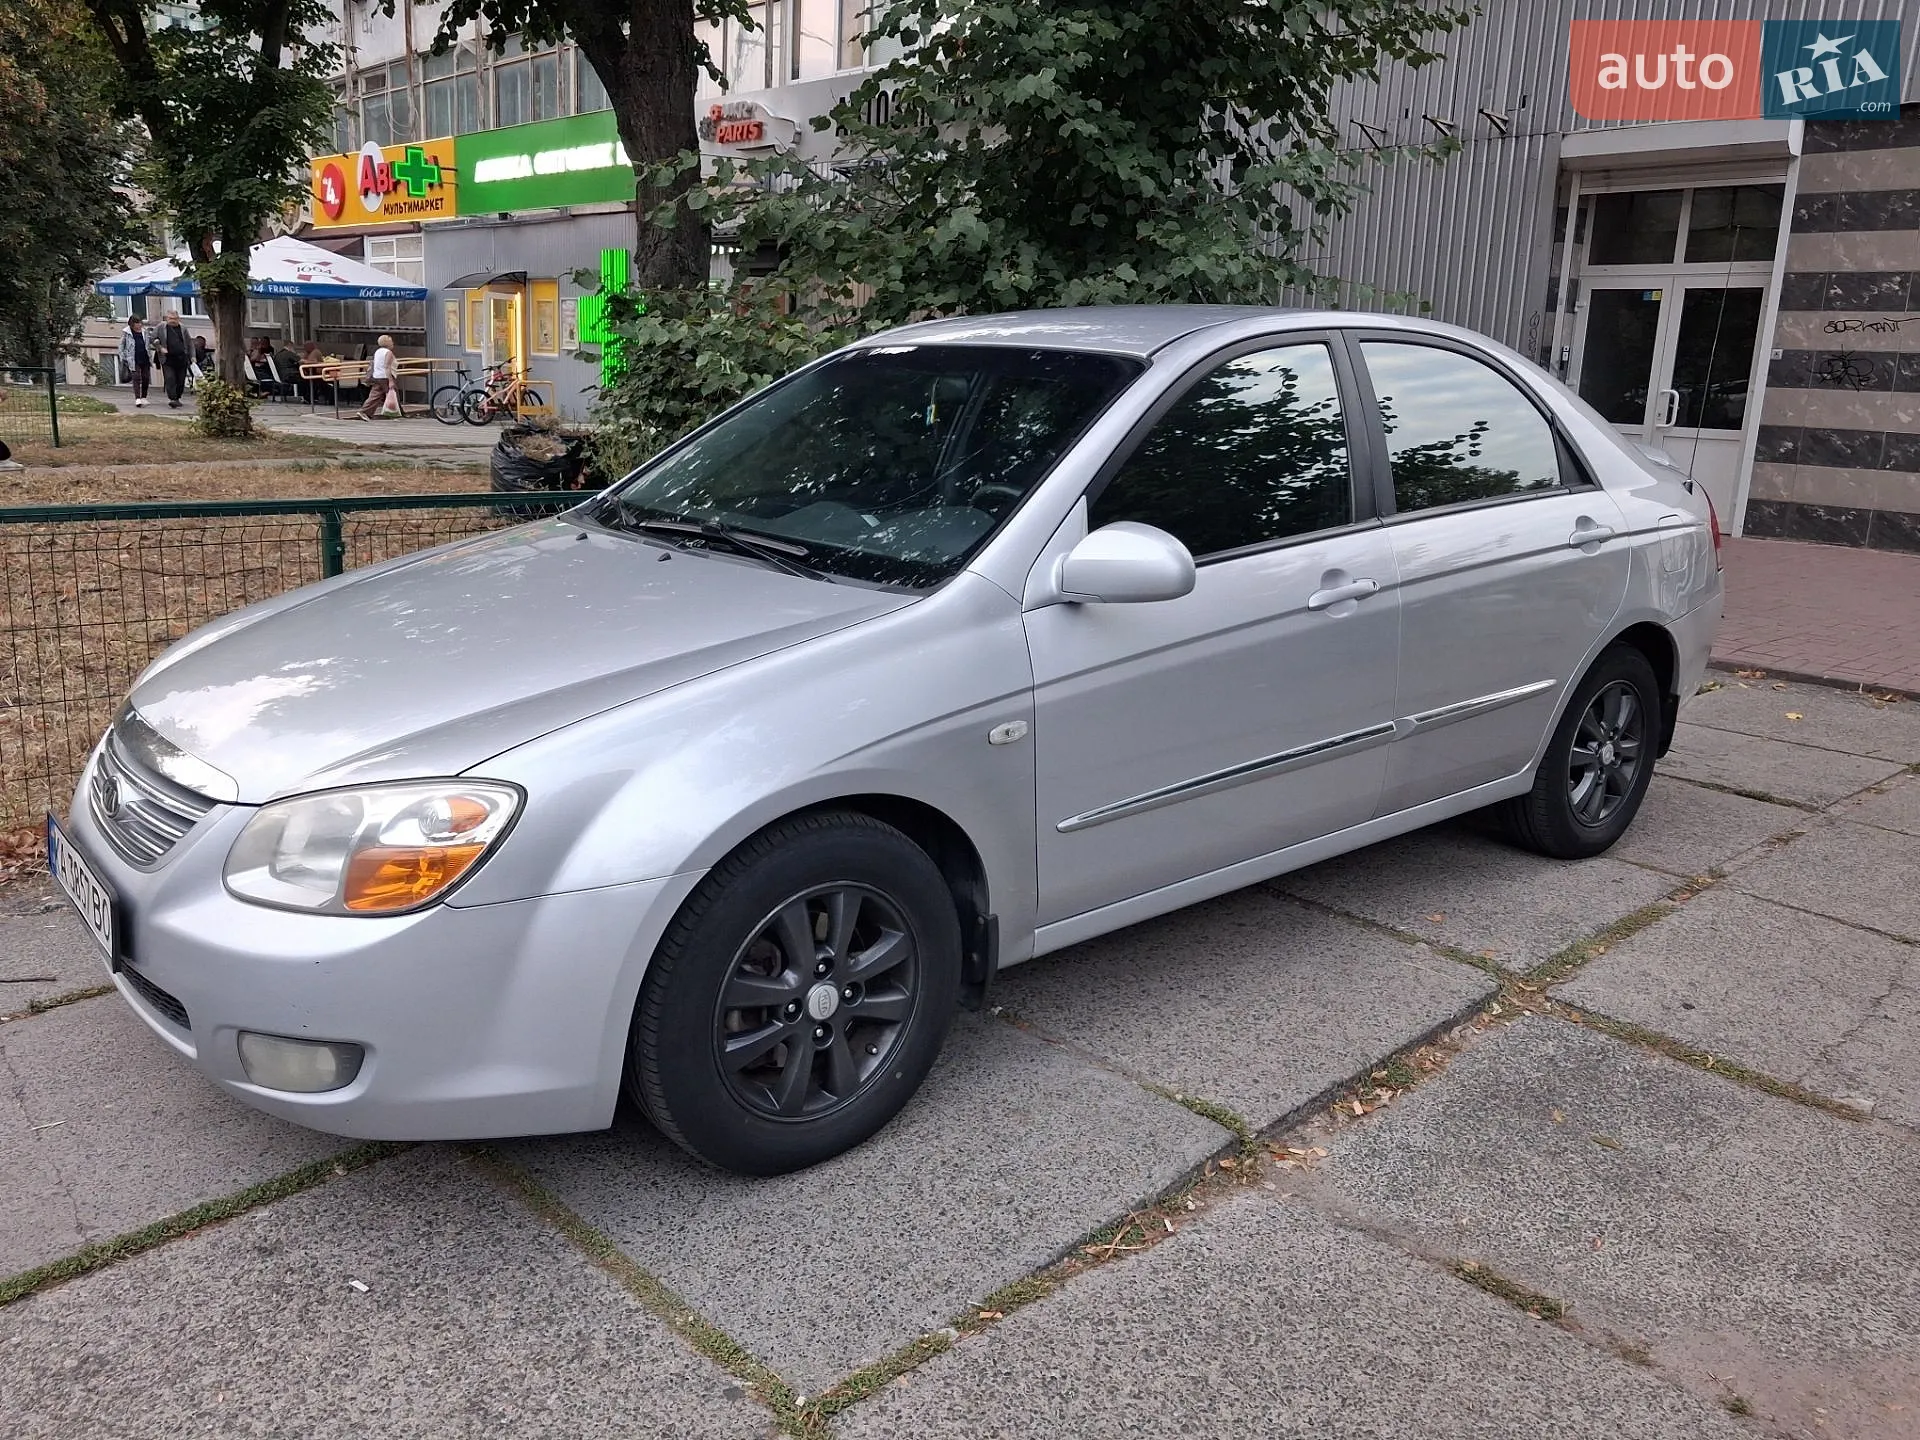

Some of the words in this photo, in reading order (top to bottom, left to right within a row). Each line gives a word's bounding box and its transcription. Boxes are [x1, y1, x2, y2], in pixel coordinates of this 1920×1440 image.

[716, 120, 763, 144] PARTS
[383, 197, 445, 216] МУЛЬТИМАРКЕТ
[297, 265, 332, 275] 1664
[268, 284, 301, 295] FRANCE
[359, 288, 383, 298] 1664
[386, 289, 415, 298] FRANCE
